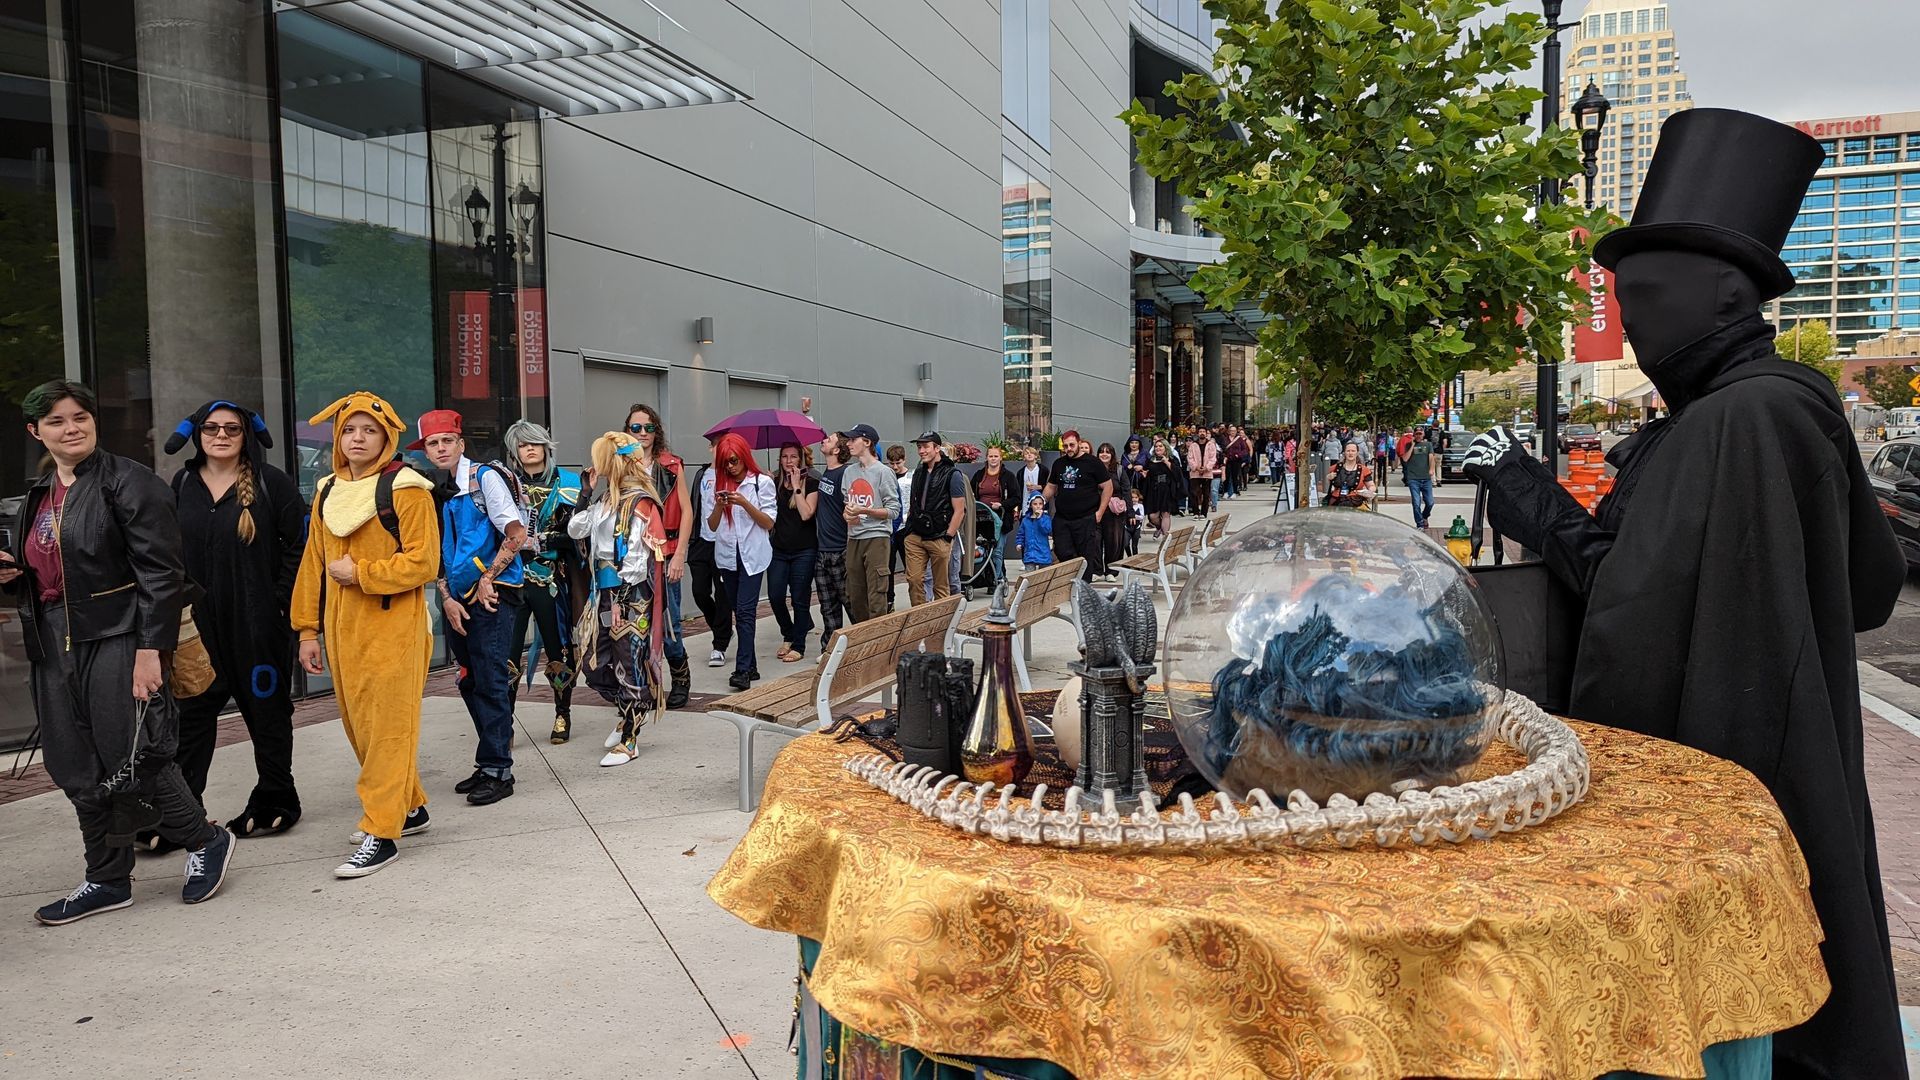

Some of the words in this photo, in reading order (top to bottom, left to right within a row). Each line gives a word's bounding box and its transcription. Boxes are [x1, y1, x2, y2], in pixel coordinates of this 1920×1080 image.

[1794, 115, 1882, 137] Marriott
[1589, 258, 1606, 332] entrat
[847, 493, 874, 509] NASA
